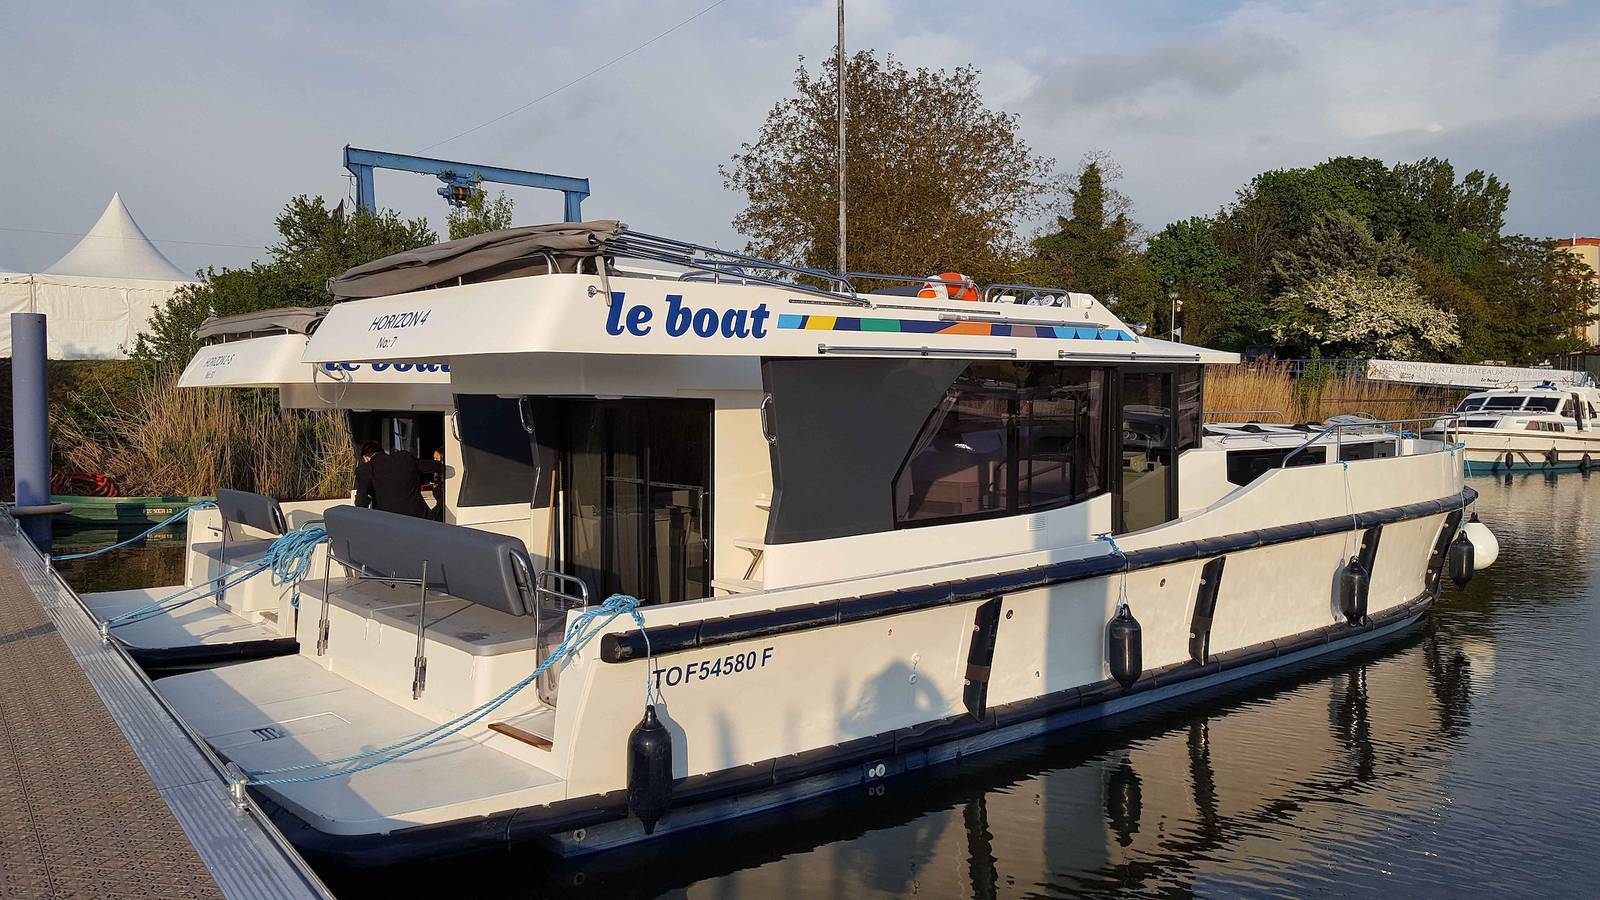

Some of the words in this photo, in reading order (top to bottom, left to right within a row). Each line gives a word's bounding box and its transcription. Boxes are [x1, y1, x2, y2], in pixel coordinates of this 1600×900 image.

[368, 311, 423, 332] HORIZON
[605, 291, 653, 337] le
[665, 294, 770, 340] boat
[761, 647, 774, 667] F
